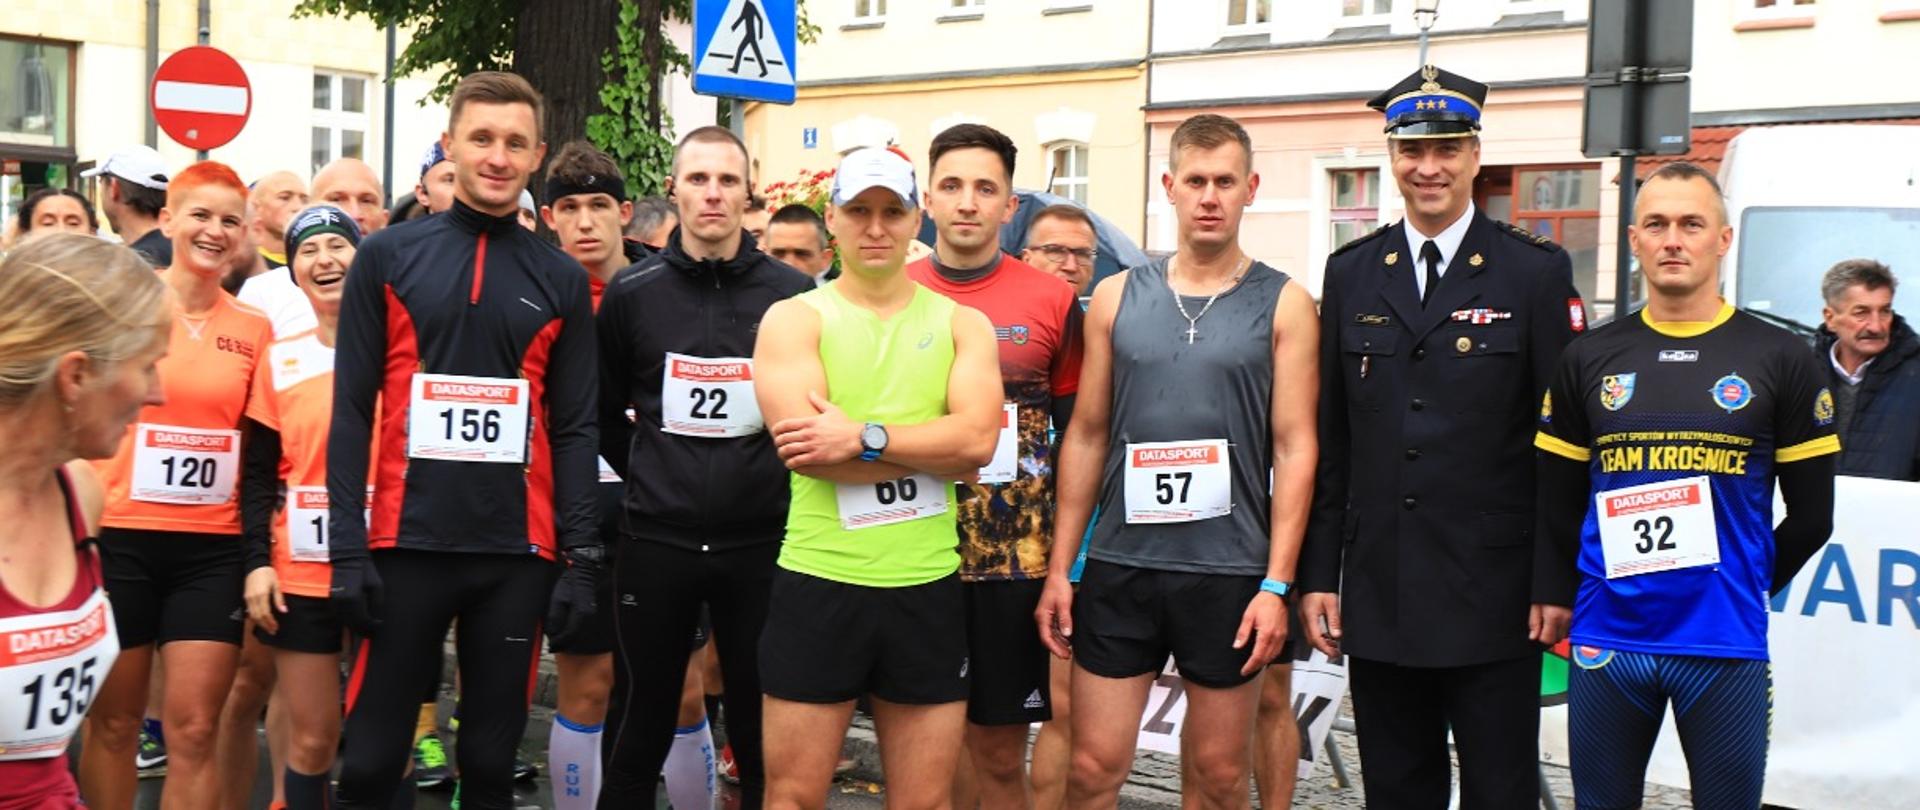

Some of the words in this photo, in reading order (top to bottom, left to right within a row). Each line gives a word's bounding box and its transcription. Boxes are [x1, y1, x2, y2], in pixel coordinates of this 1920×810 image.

[677, 362, 743, 377] DATASPORT
[431, 383, 512, 399] DATASPORT
[690, 388, 728, 419] 22
[154, 432, 226, 448] DATASPORT
[440, 408, 501, 443] 156
[1139, 447, 1209, 461] DATASPORT
[1600, 445, 1644, 473] TEAM
[1649, 442, 1748, 475] KROŚNICE
[162, 456, 216, 488] 120
[1156, 472, 1192, 505] 57
[1613, 487, 1691, 510] DATASPORT
[1633, 516, 1676, 554] 32
[1770, 543, 1920, 630] AR
[23, 656, 97, 730] 135
[566, 762, 580, 798] RUN
